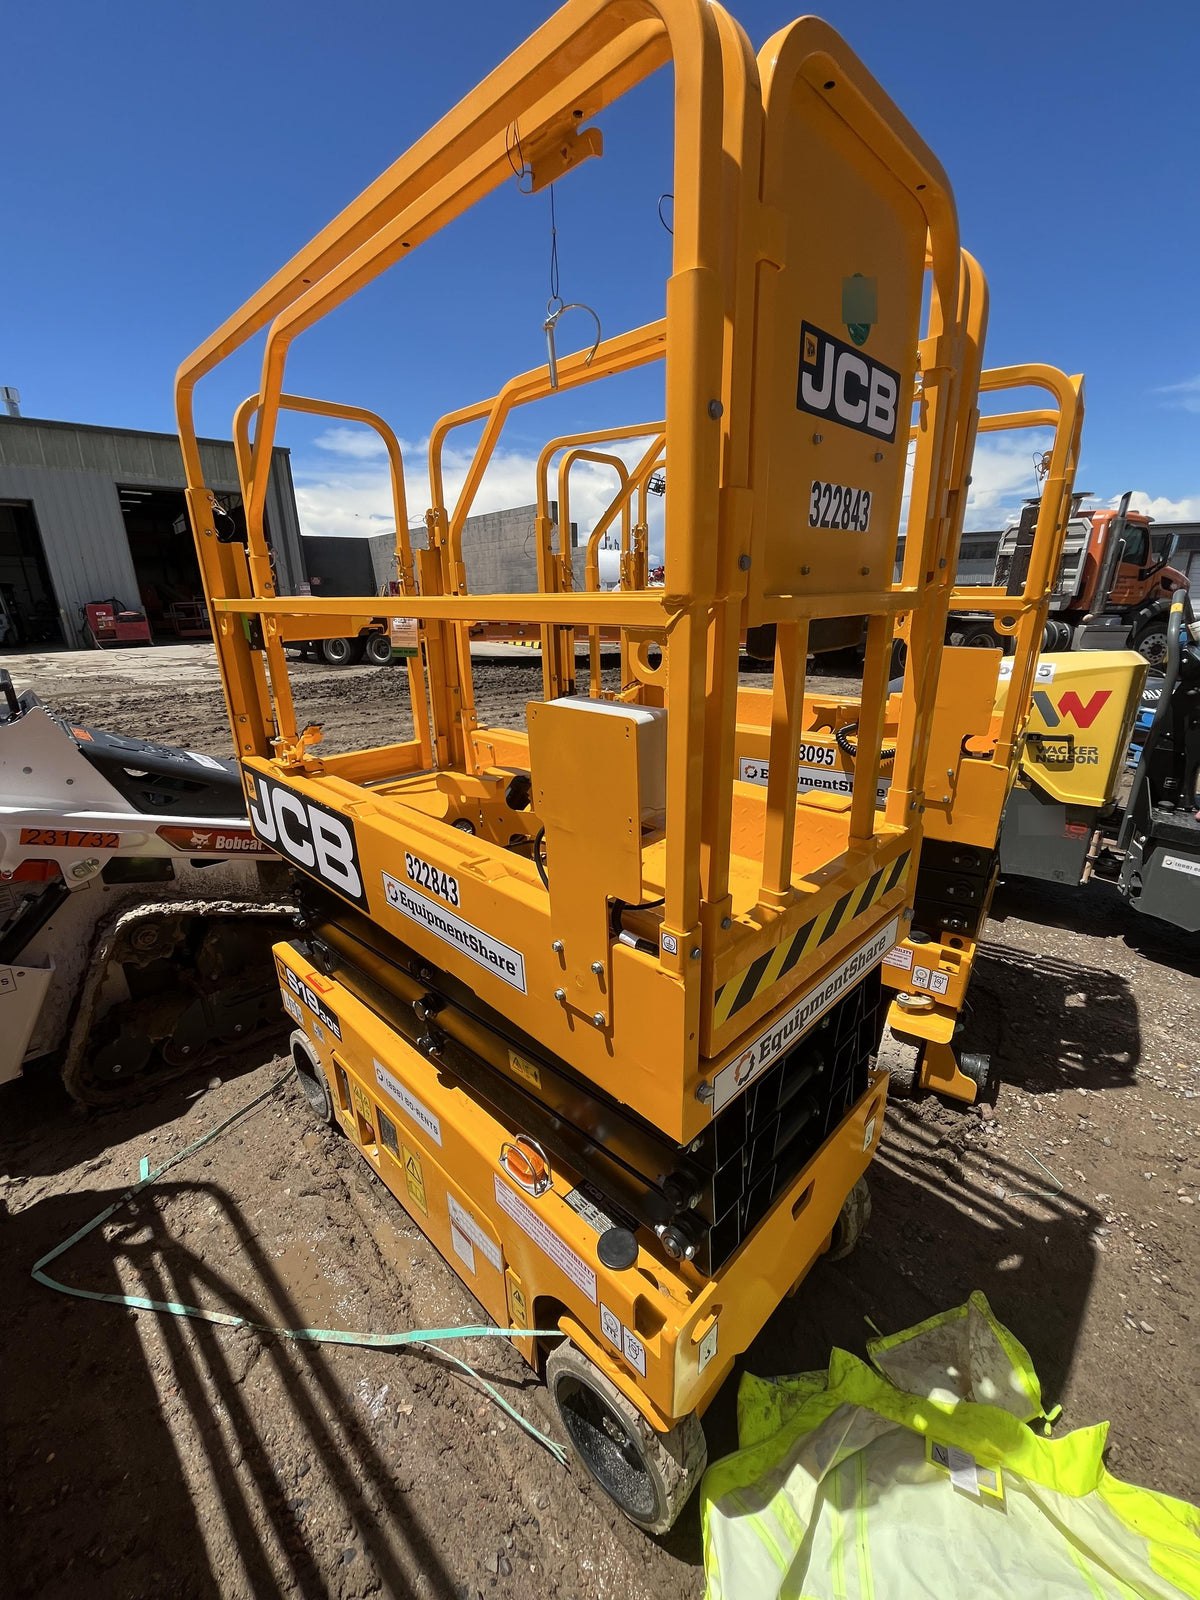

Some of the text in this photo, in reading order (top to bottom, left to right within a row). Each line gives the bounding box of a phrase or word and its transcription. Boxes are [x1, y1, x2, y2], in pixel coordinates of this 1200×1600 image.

[801, 342, 897, 435] JCB
[809, 480, 871, 531] 322843
[1035, 745, 1099, 755] WACKER
[1035, 754, 1099, 765] NEUSON
[26, 828, 119, 848] 231732
[215, 835, 262, 850] Bobcat
[250, 778, 362, 898] JCB
[405, 852, 459, 907] 322843
[399, 889, 516, 977] EquipmentShare
[758, 935, 887, 1064] EquipmentShare
